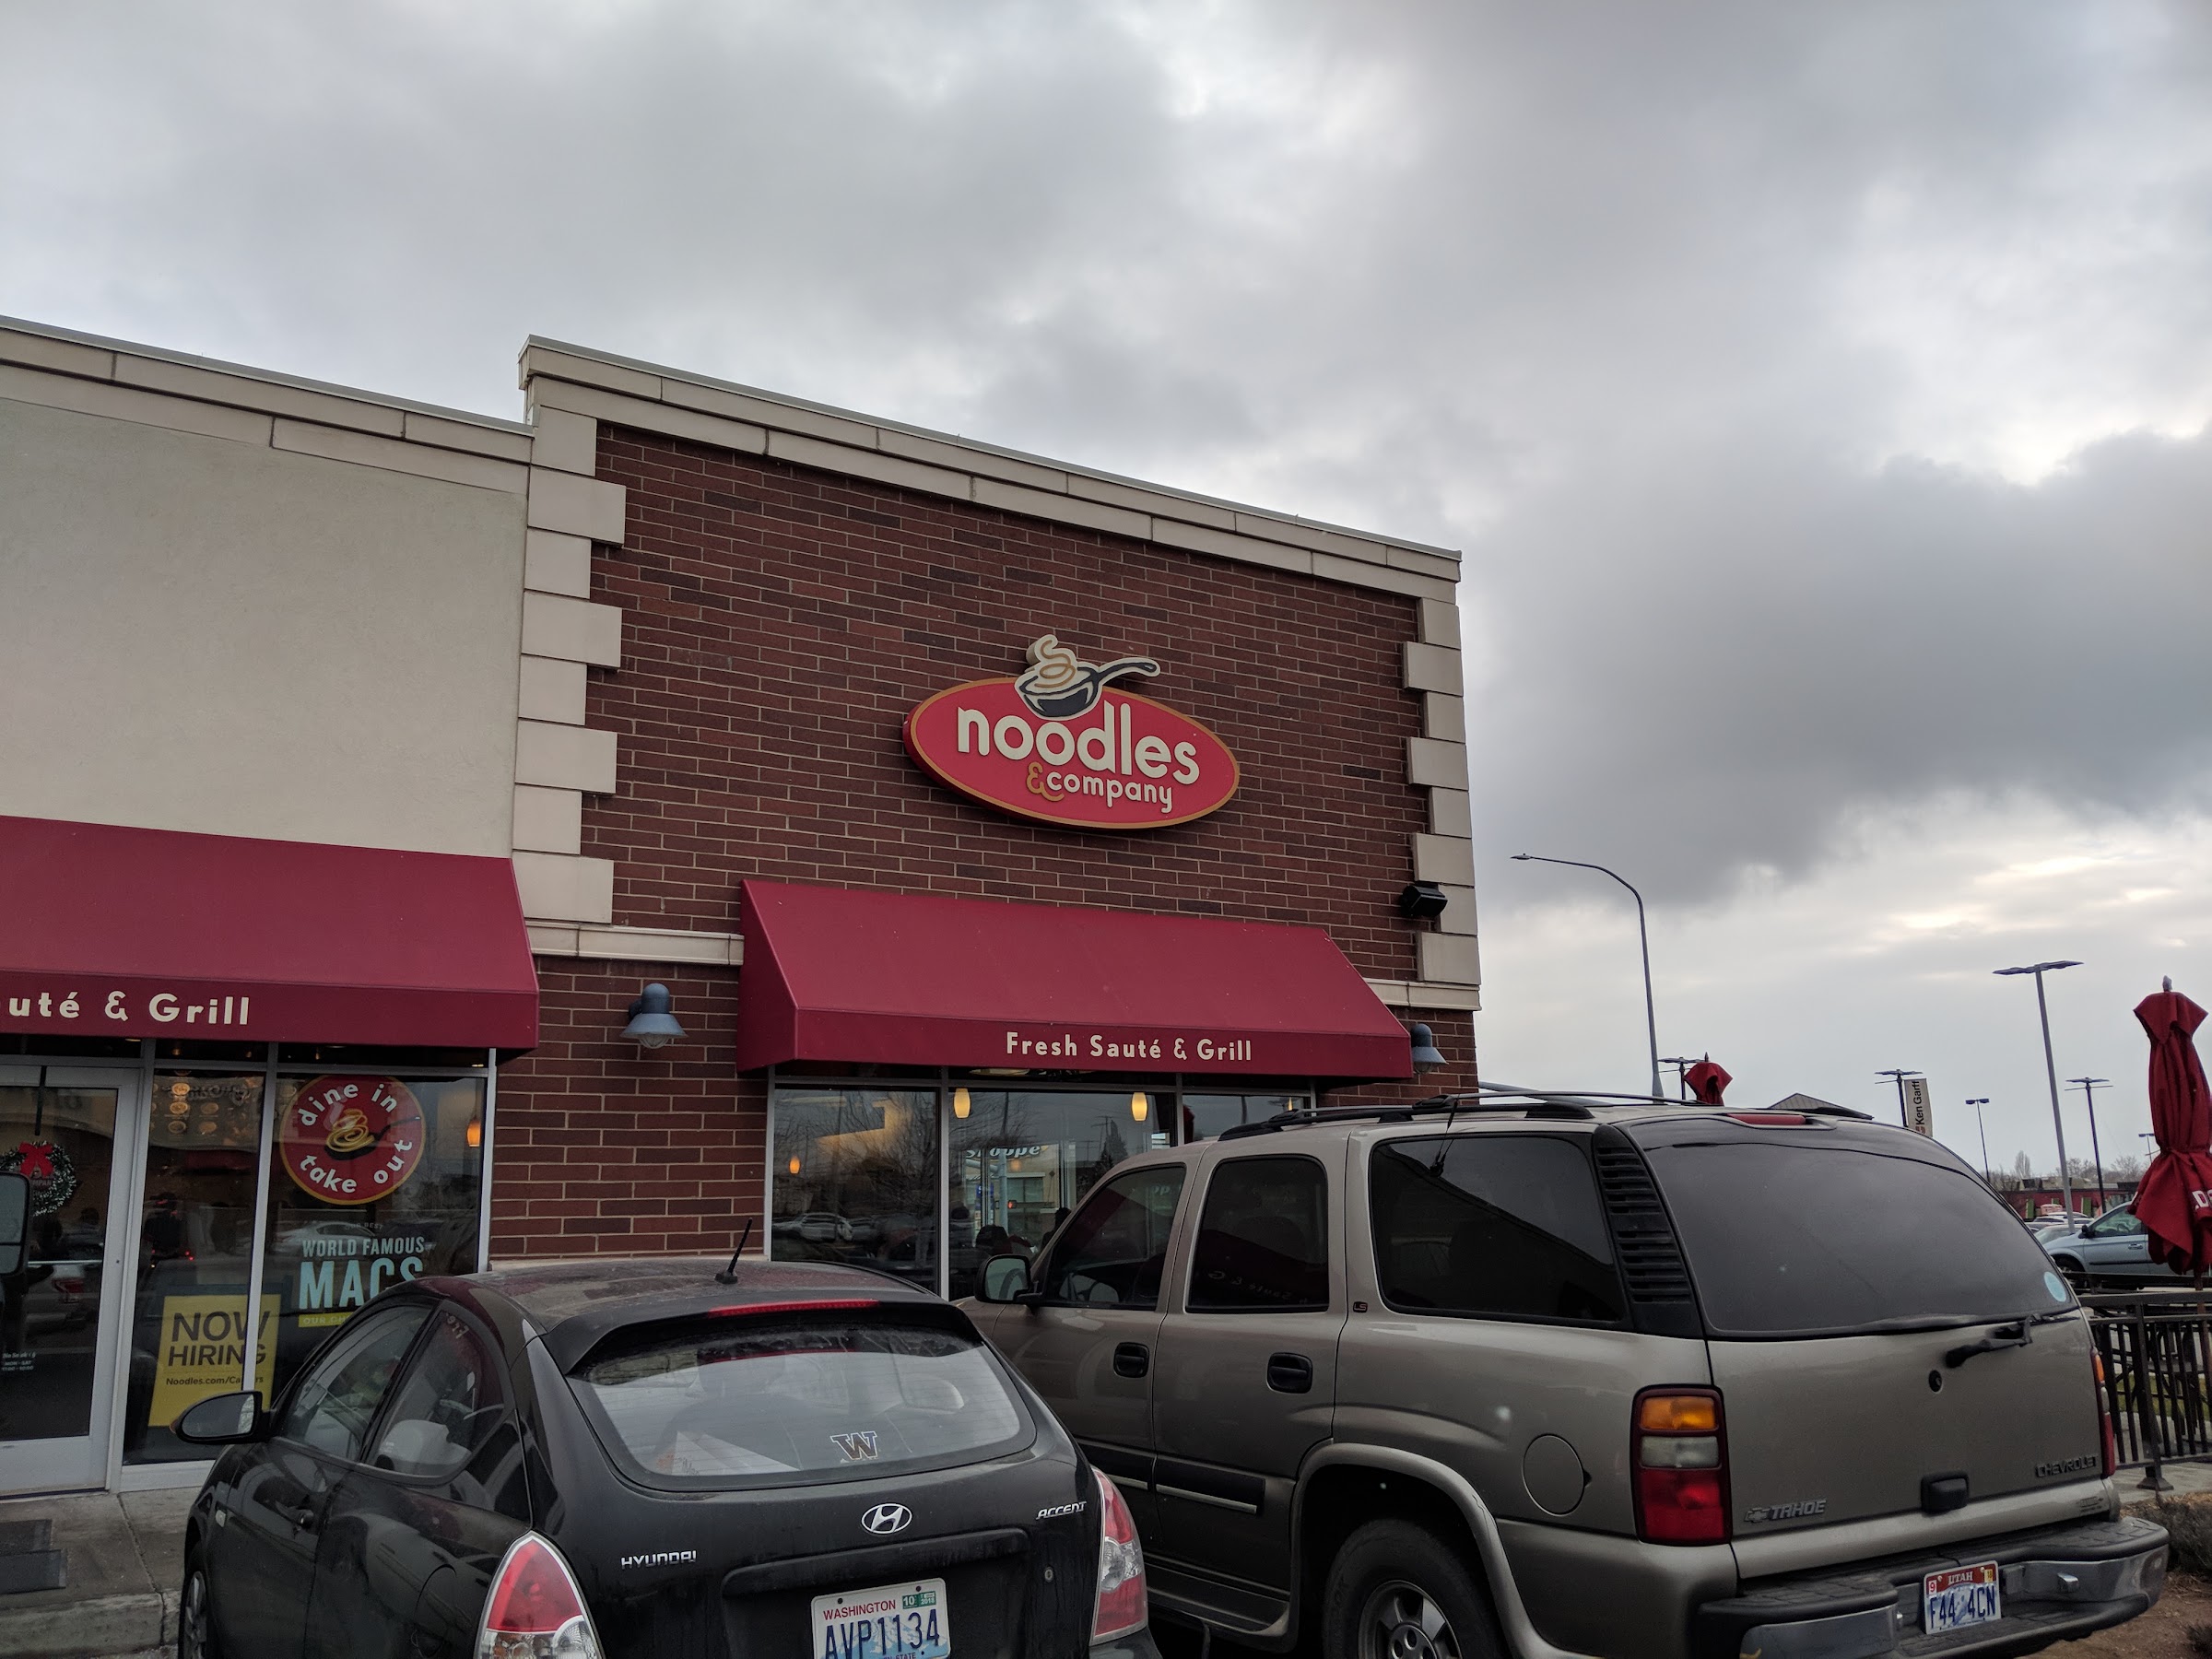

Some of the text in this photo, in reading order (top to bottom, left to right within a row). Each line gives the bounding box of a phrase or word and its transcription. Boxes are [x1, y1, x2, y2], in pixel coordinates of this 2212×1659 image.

[957, 700, 1200, 784] noodles
[1046, 771, 1173, 814] company
[8, 990, 250, 1025] uté & Grill
[1006, 1031, 1252, 1061] Fresh Sauté & Grill
[298, 1083, 397, 1126] dine in
[1914, 1106, 1925, 1125] Ken
[300, 1139, 413, 1194] take out
[302, 1236, 425, 1258] WORLD FAMOUS
[299, 1256, 423, 1310] MACS
[171, 1311, 271, 1342] NOW
[329, 1315, 349, 1324] CH
[168, 1343, 266, 1367] HIRING
[166, 1375, 264, 1386] Noodles.com/Cars
[830, 1430, 878, 1460] W
[2035, 1454, 2100, 1478] CHEVROLET
[1034, 1501, 1087, 1521] ACCENT
[1769, 1499, 1827, 1521] TAHOE
[620, 1549, 697, 1570] HYUNDAI
[1929, 1582, 1936, 1593] 9
[1947, 1571, 1973, 1585] UTAH
[823, 1599, 897, 1621] WASHINGTON
[903, 1596, 915, 1606] 10
[1930, 1585, 1995, 1630] F44 4CN
[825, 1608, 940, 1659] AVP1134
